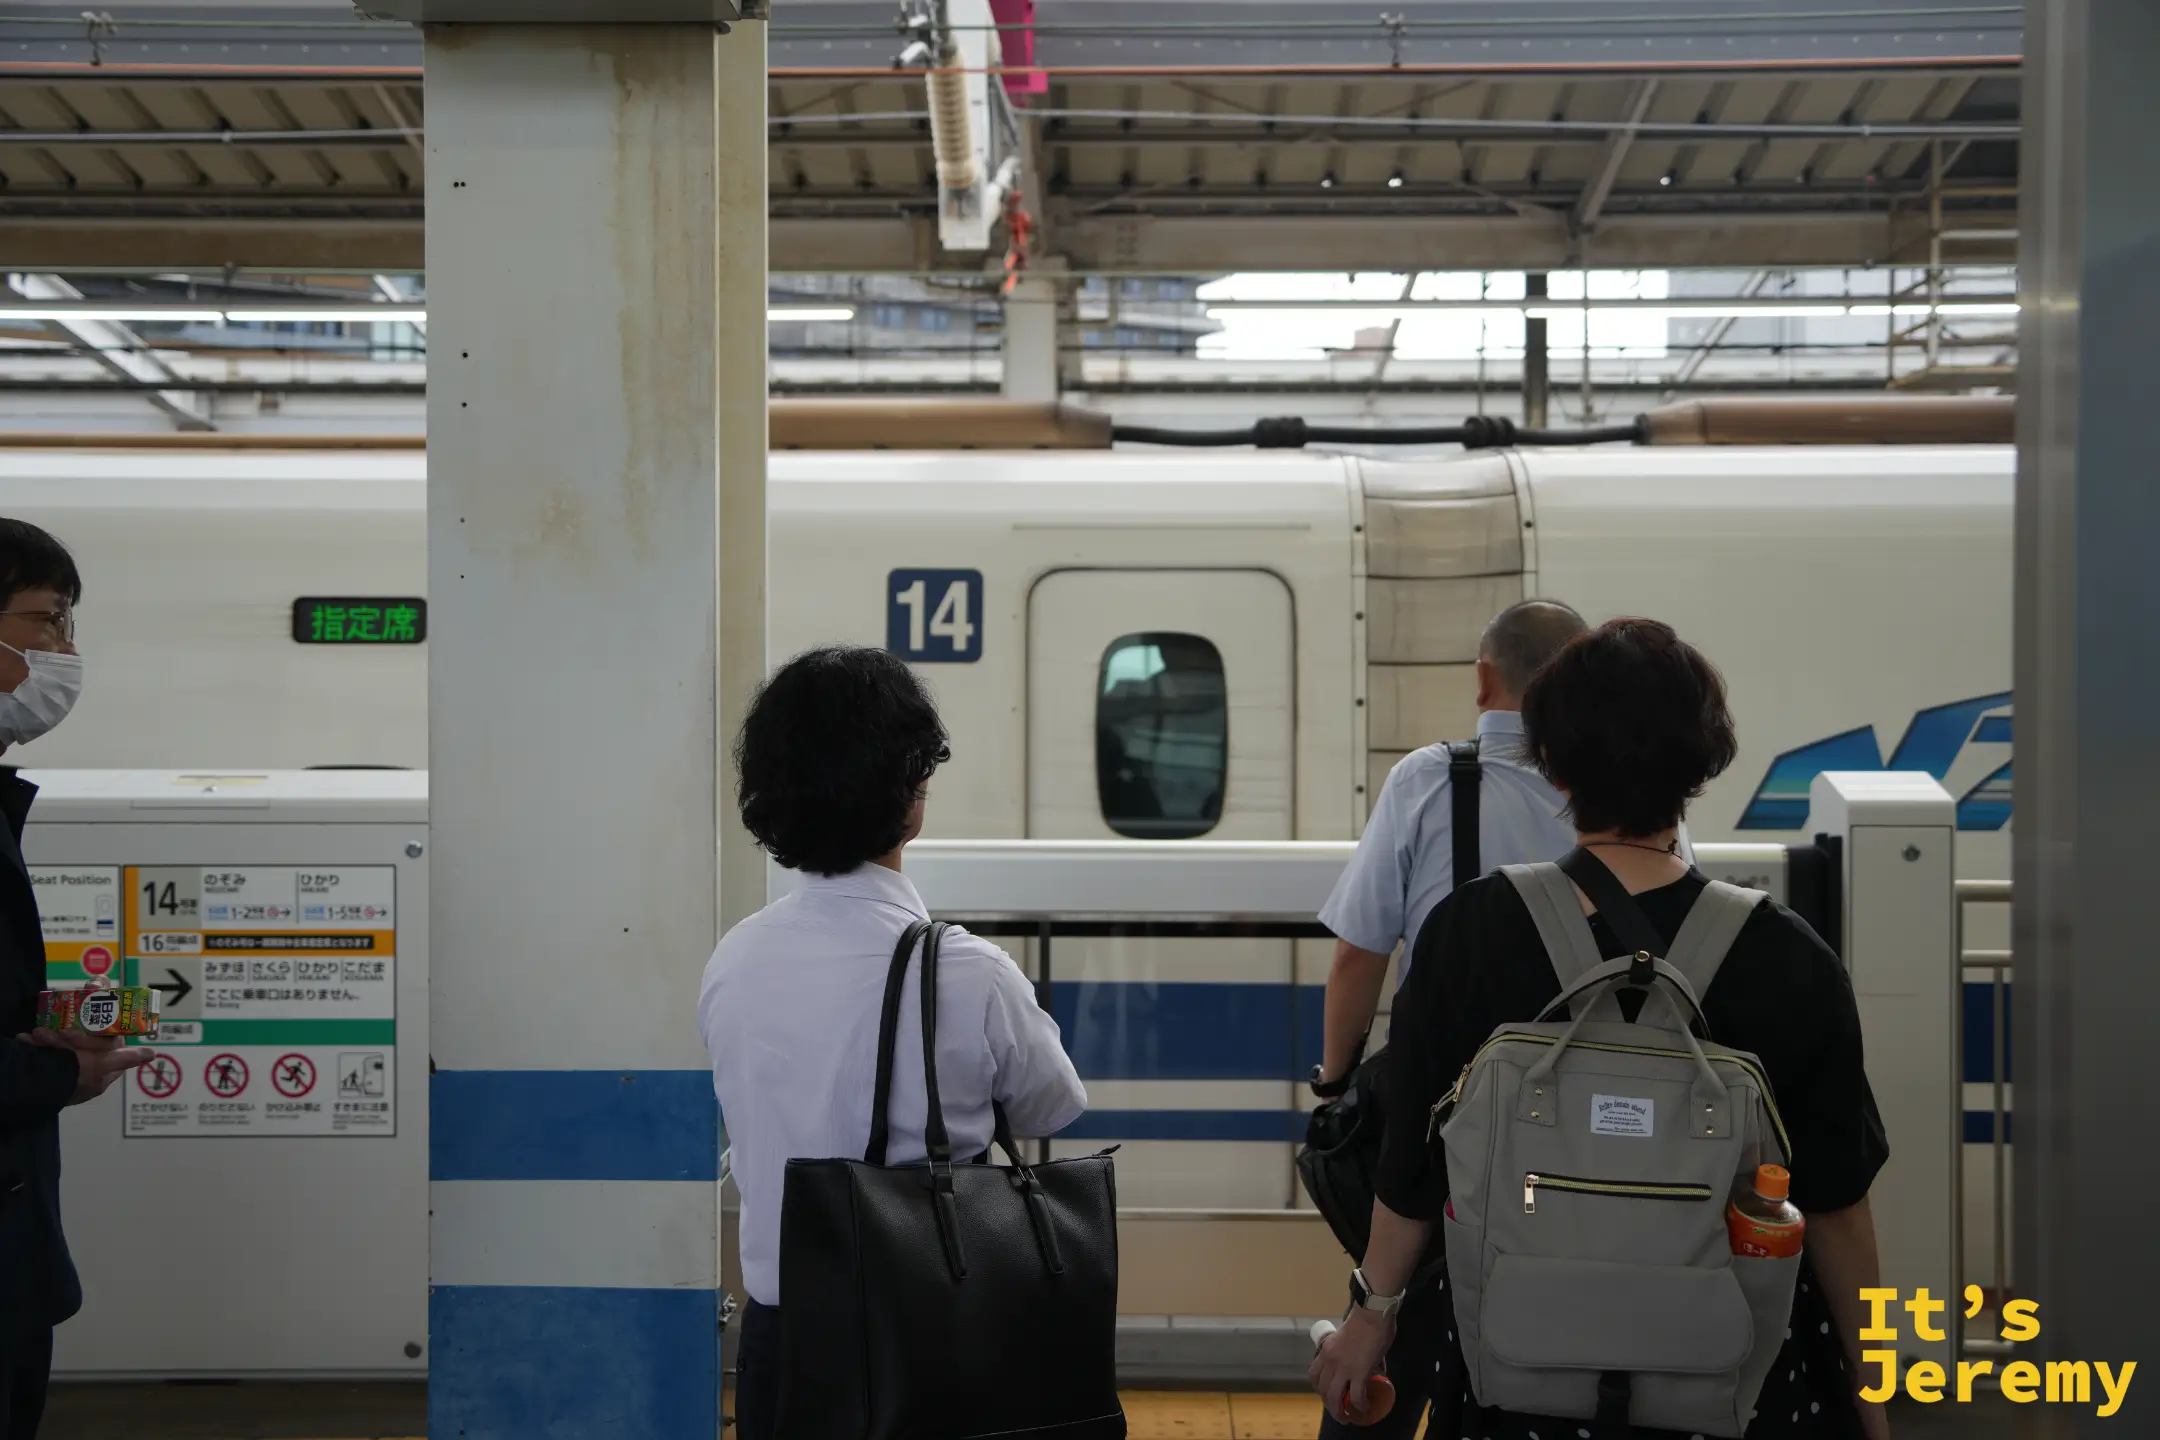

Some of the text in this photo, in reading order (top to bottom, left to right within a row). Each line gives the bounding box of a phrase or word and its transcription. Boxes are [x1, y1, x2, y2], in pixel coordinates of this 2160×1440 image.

[896, 580, 973, 651] 14
[311, 604, 419, 641] 指定席
[30, 874, 112, 885] Seat Position
[203, 873, 247, 887] のぞみ
[300, 874, 341, 887] ひかり
[143, 881, 179, 916] 14
[141, 934, 165, 952] 16
[204, 961, 245, 974] みずほ
[252, 961, 291, 974] さくら
[299, 961, 339, 974] ひかり
[344, 961, 386, 974] こだま
